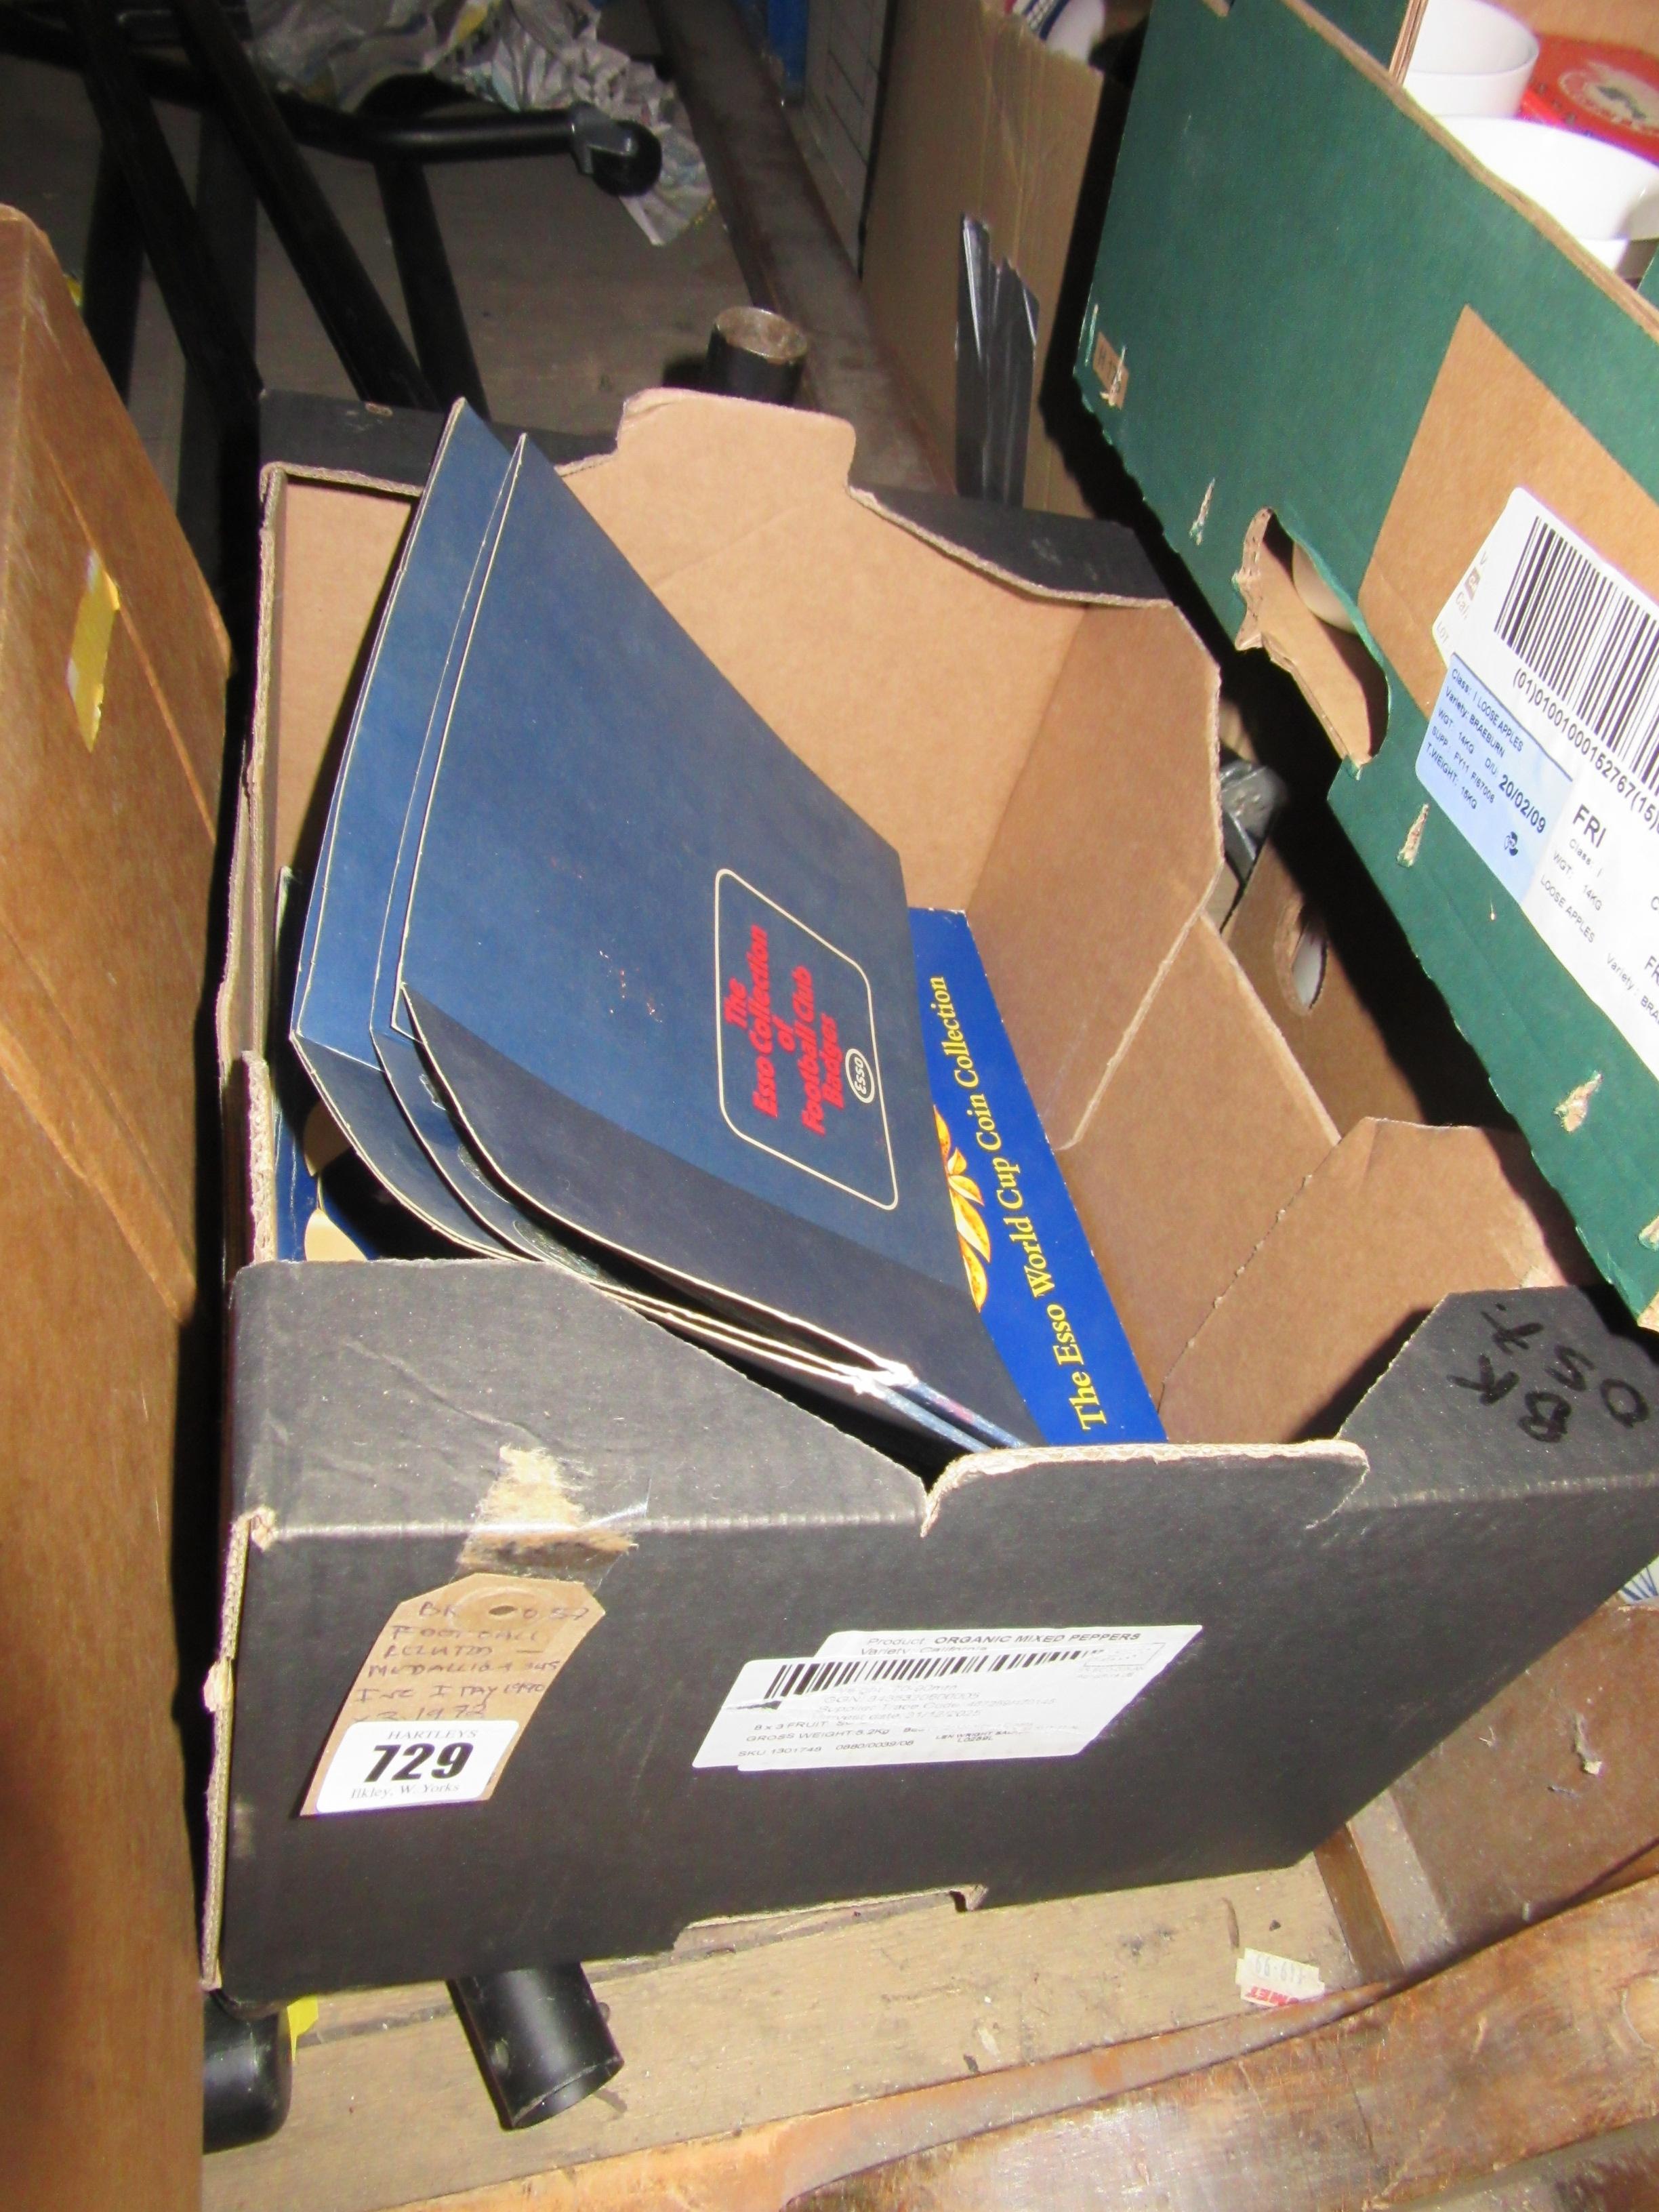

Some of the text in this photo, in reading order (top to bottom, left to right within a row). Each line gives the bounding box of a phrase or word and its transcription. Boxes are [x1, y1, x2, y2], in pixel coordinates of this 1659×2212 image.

[1446, 686, 1505, 758] Variety: BRAEBURN
[1477, 697, 1499, 726] LOOSE
[1498, 720, 1523, 752] APPLES
[1513, 668, 1659, 835] (01)01001000152767(15)
[1458, 731, 1475, 754] 14KG
[1498, 773, 1547, 834] 20/02/09
[1572, 803, 1607, 849] FRI
[1540, 874, 1595, 943] LOOSE APPLES
[1582, 884, 1603, 912] 14KG
[724, 976, 748, 1030] The
[746, 923, 777, 1119] Esso Collection
[1640, 994, 1659, 1025] BRA
[772, 1014, 796, 1054] of
[792, 965, 825, 1136] Football Club
[819, 1012, 845, 1110] Badges
[930, 976, 1107, 1431] The Esso World Cup Coin Collection
[935, 1635, 1012, 1644] ORGANIC
[1015, 1635, 1065, 1643] MIXED
[388, 1729, 478, 1740] HARTLEYS
[746, 1732, 796, 1742] GROSS
[787, 1721, 827, 1729] FRUIT
[363, 1742, 474, 1783] 729
[422, 1782, 460, 1793] Yorks
